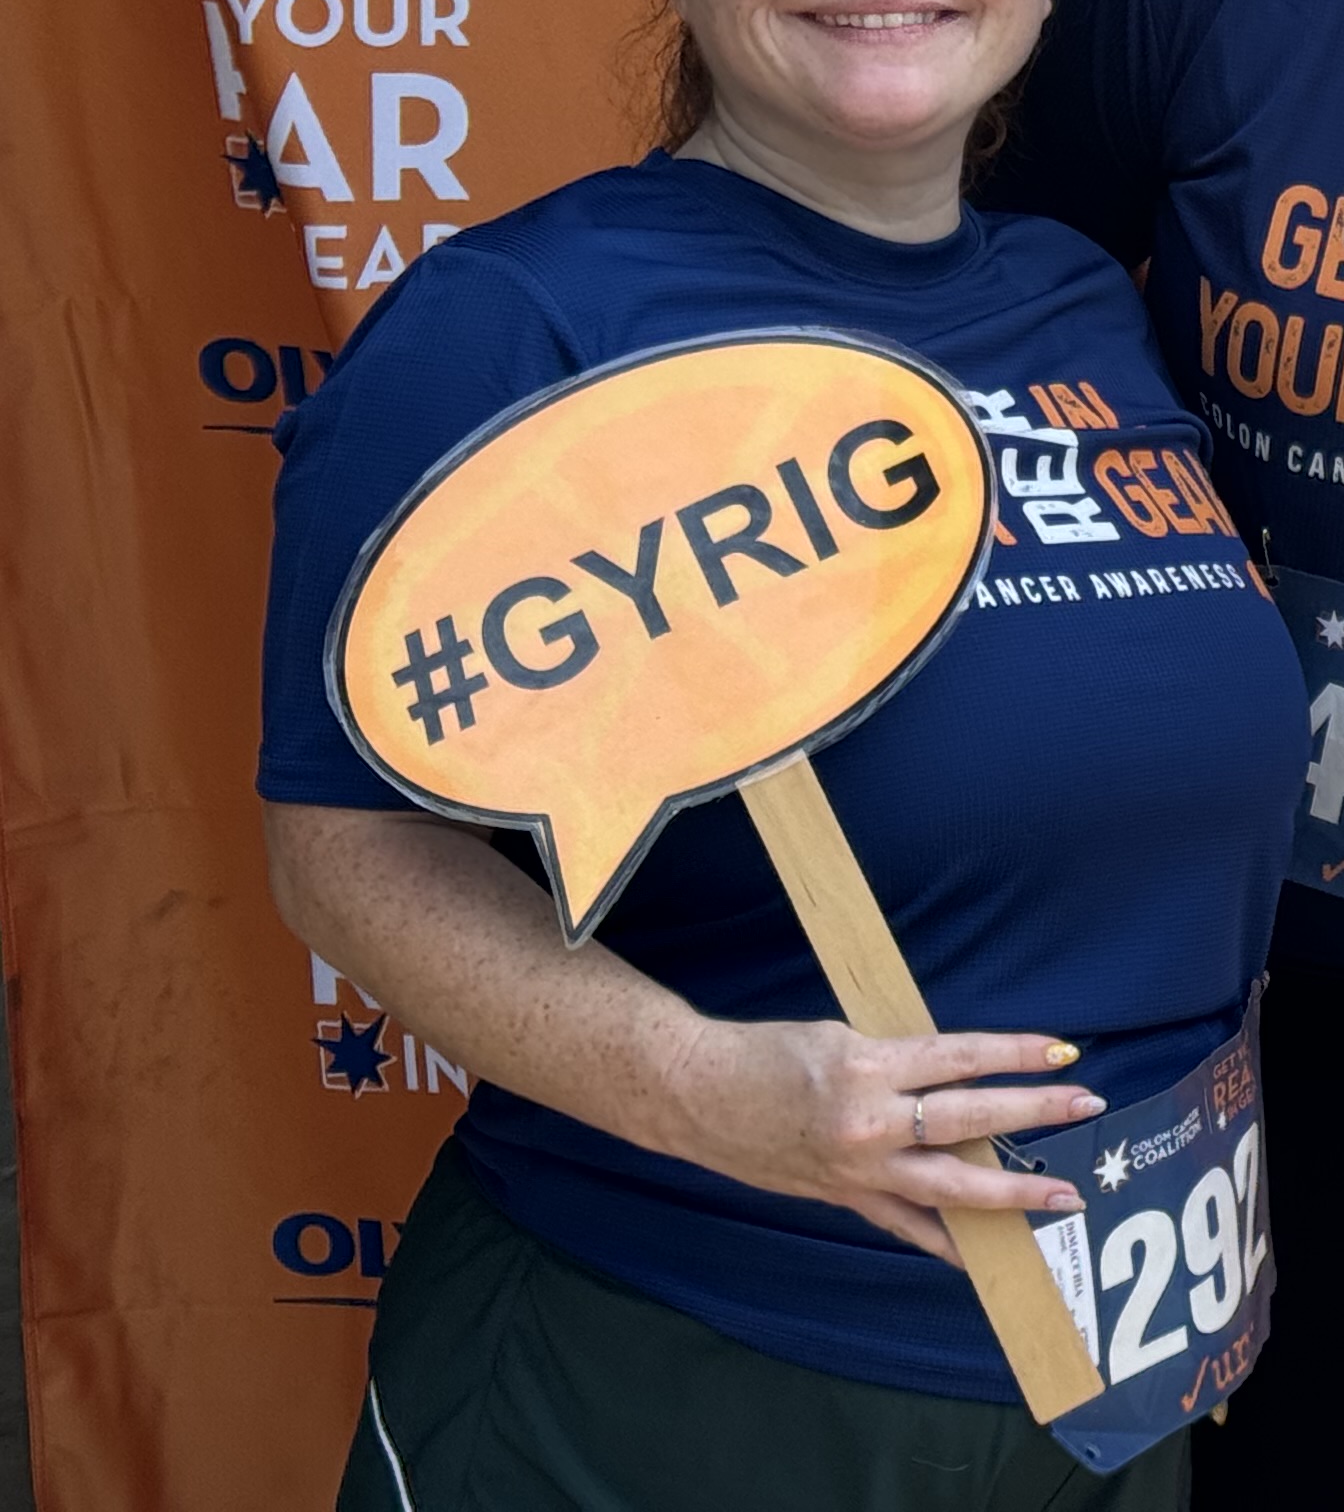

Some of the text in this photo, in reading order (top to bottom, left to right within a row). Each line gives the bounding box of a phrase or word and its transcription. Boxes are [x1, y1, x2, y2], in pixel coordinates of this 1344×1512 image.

[1028, 382, 1119, 429] IN
[1200, 392, 1270, 462] COLON
[1094, 449, 1240, 537] GEA
[392, 419, 941, 746] #GYRIG
[957, 564, 1246, 611] ANCER AWARENESS
[1130, 1129, 1172, 1156] COLON
[1101, 1122, 1266, 1385] 292
